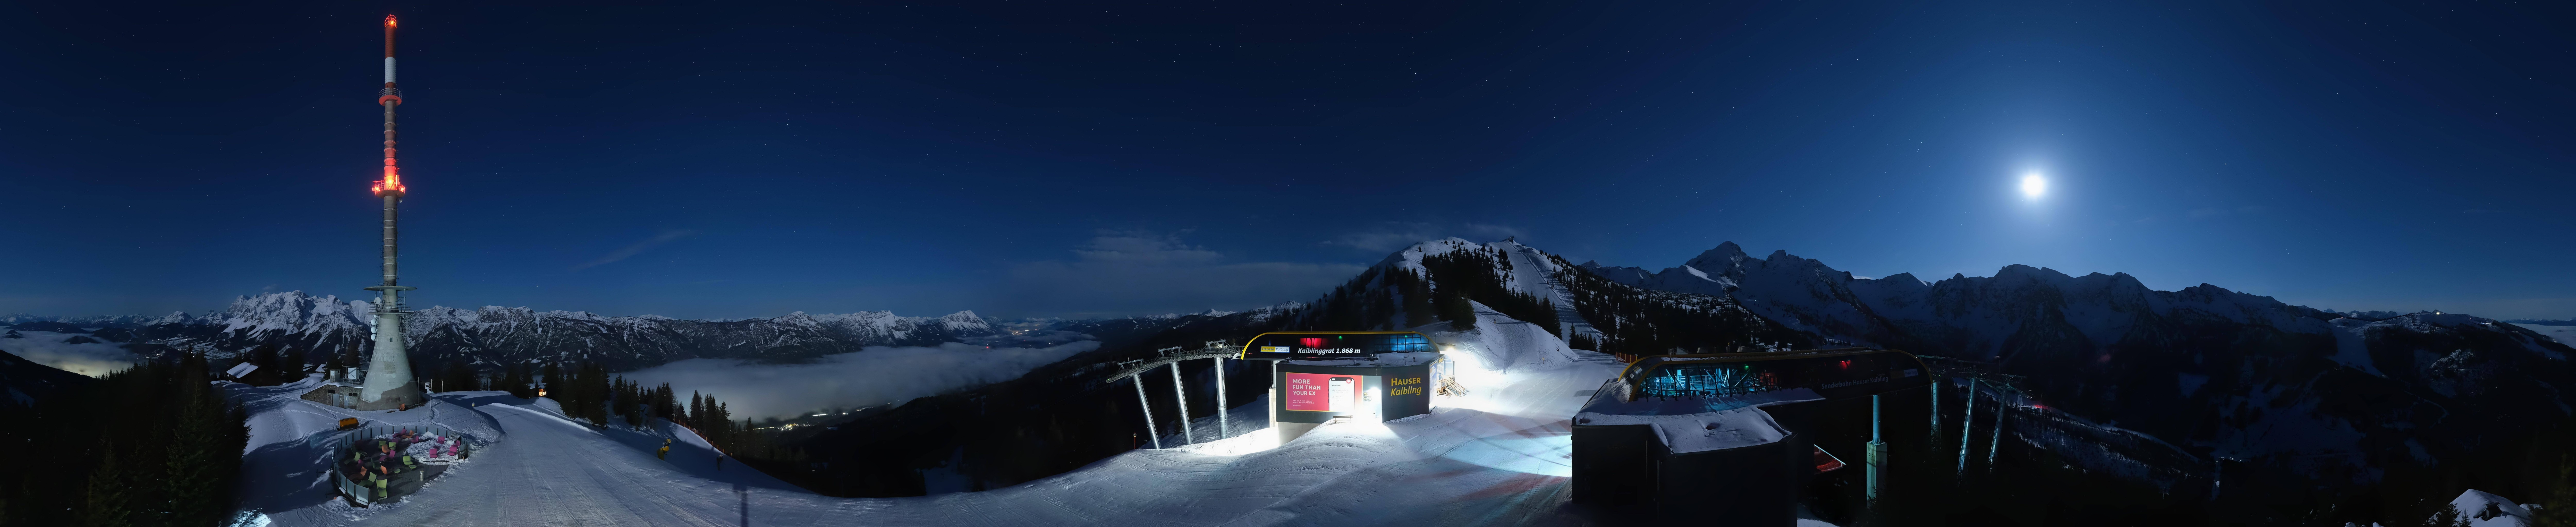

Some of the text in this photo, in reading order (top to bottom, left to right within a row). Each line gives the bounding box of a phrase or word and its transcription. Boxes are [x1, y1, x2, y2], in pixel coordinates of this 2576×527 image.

[1391, 377, 1421, 386] HAUSER
[1821, 380, 1852, 389] Senderbahn
[1391, 386, 1421, 396] Kaibling
